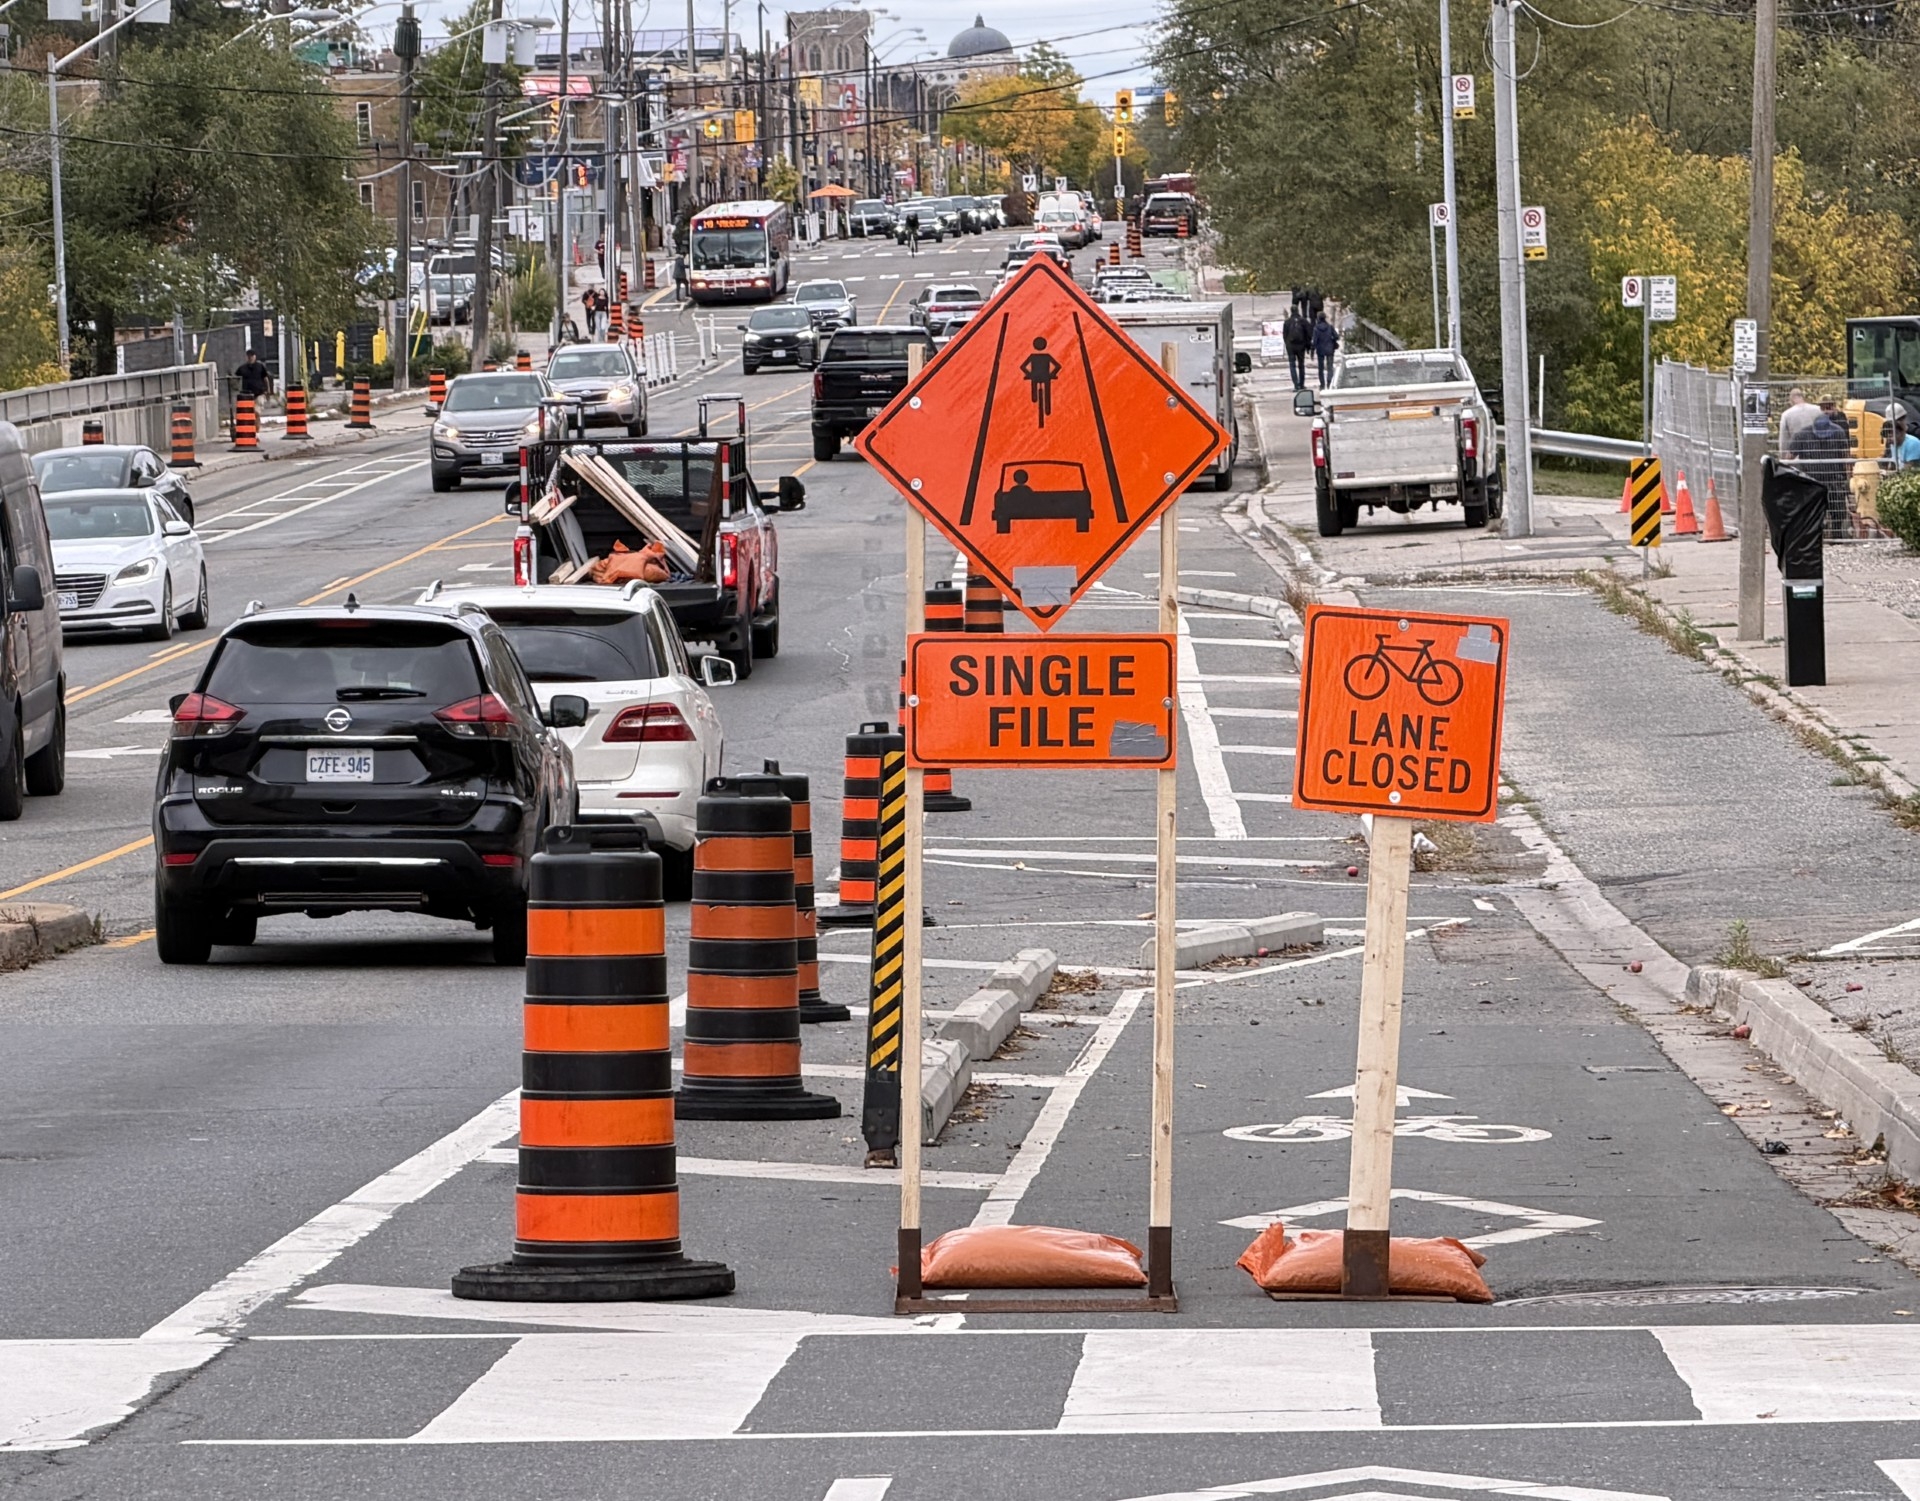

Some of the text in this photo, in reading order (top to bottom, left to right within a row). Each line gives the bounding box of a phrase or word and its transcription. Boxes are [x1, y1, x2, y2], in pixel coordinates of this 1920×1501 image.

[949, 654, 1135, 697] SINGLE
[989, 706, 1095, 747] FILE
[1349, 710, 1450, 752] LANE
[310, 756, 371, 774] CZFE 945
[1322, 749, 1471, 794] CLOSED
[198, 786, 243, 794] ROGUE
